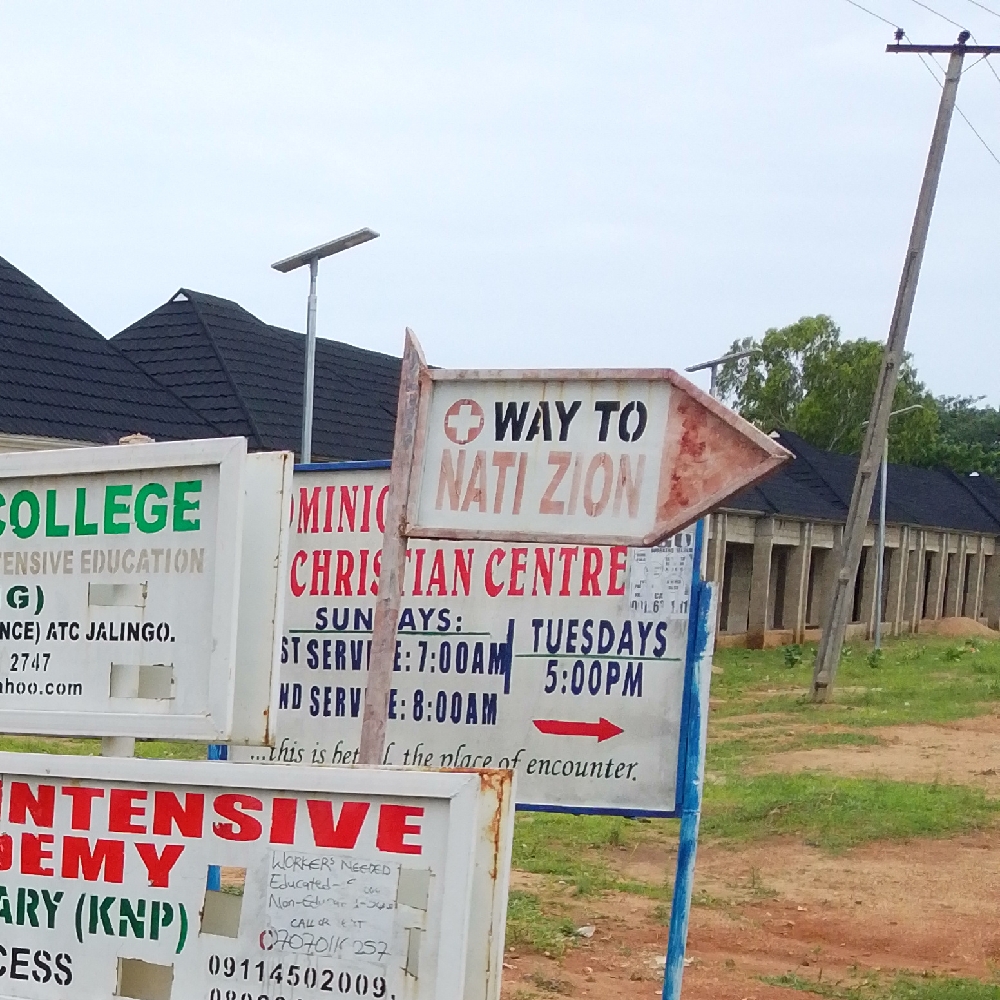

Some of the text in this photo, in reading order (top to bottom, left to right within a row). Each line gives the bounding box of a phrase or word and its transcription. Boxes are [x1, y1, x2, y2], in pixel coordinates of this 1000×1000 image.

[494, 400, 648, 442] WAY TO
[435, 448, 647, 519] NATI ZION
[290, 485, 389, 534] MINI
[81, 548, 205, 574] EDUCATION
[484, 546, 627, 597] CENTRE
[46, 622, 79, 641] ATC
[86, 621, 175, 642] JALINGO.
[316, 607, 462, 632] SUNAYS:
[532, 618, 668, 658] TUESDAYS
[418, 641, 508, 675] 7:00AM
[544, 660, 643, 697] 5:00PM
[413, 689, 498, 725] 8:00AM
[311, 742, 326, 764] is
[403, 743, 433, 767] the
[527, 756, 639, 781] encounter.
[75, 893, 189, 955] (KNP)
